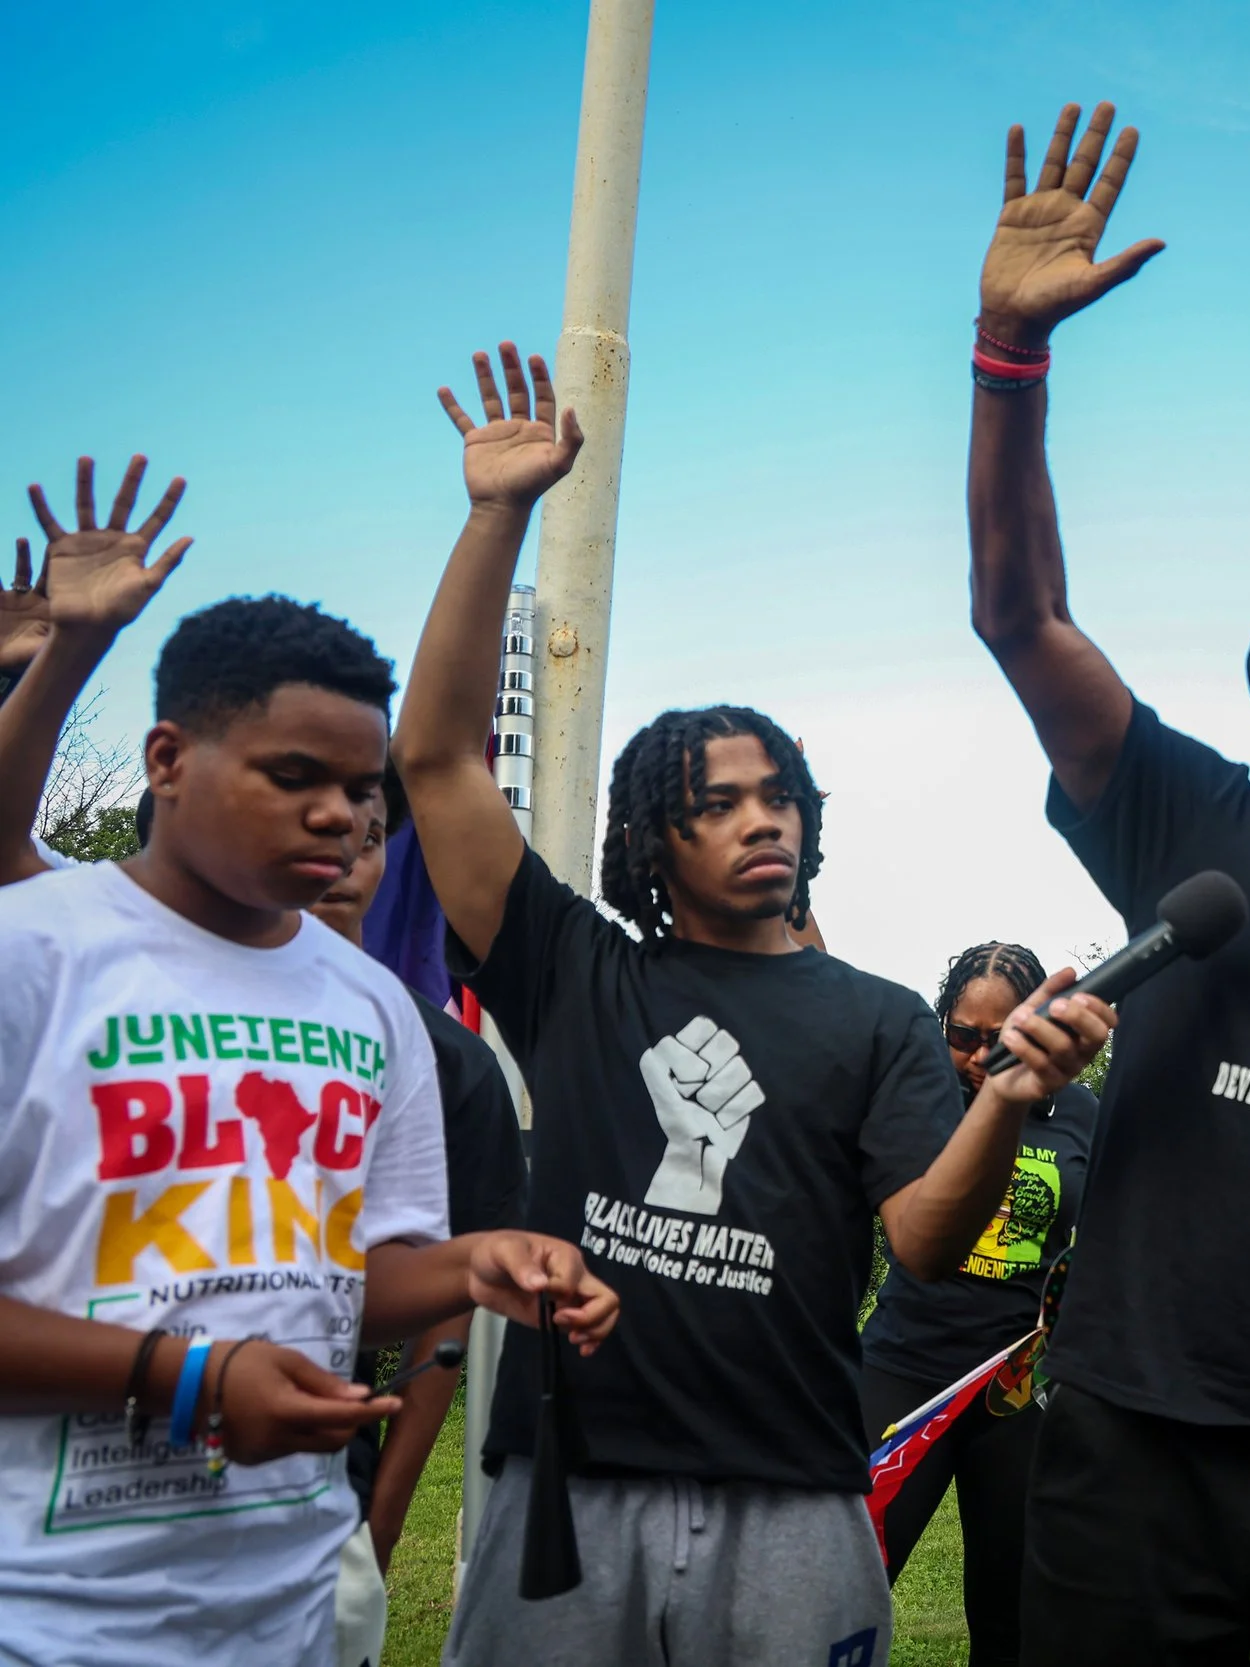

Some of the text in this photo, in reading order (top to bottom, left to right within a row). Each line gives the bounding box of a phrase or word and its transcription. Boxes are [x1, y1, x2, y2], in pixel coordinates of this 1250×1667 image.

[1036, 1147, 1057, 1163] MY
[584, 1191, 637, 1239] BLACK
[635, 1209, 695, 1254] LIVES
[607, 1237, 641, 1266] Your
[640, 1247, 683, 1280] Voice
[684, 1258, 717, 1285] For
[716, 1264, 773, 1296] Justice
[963, 1254, 1017, 1280] NDENCE
[150, 1271, 320, 1306] NUTRITIONAL
